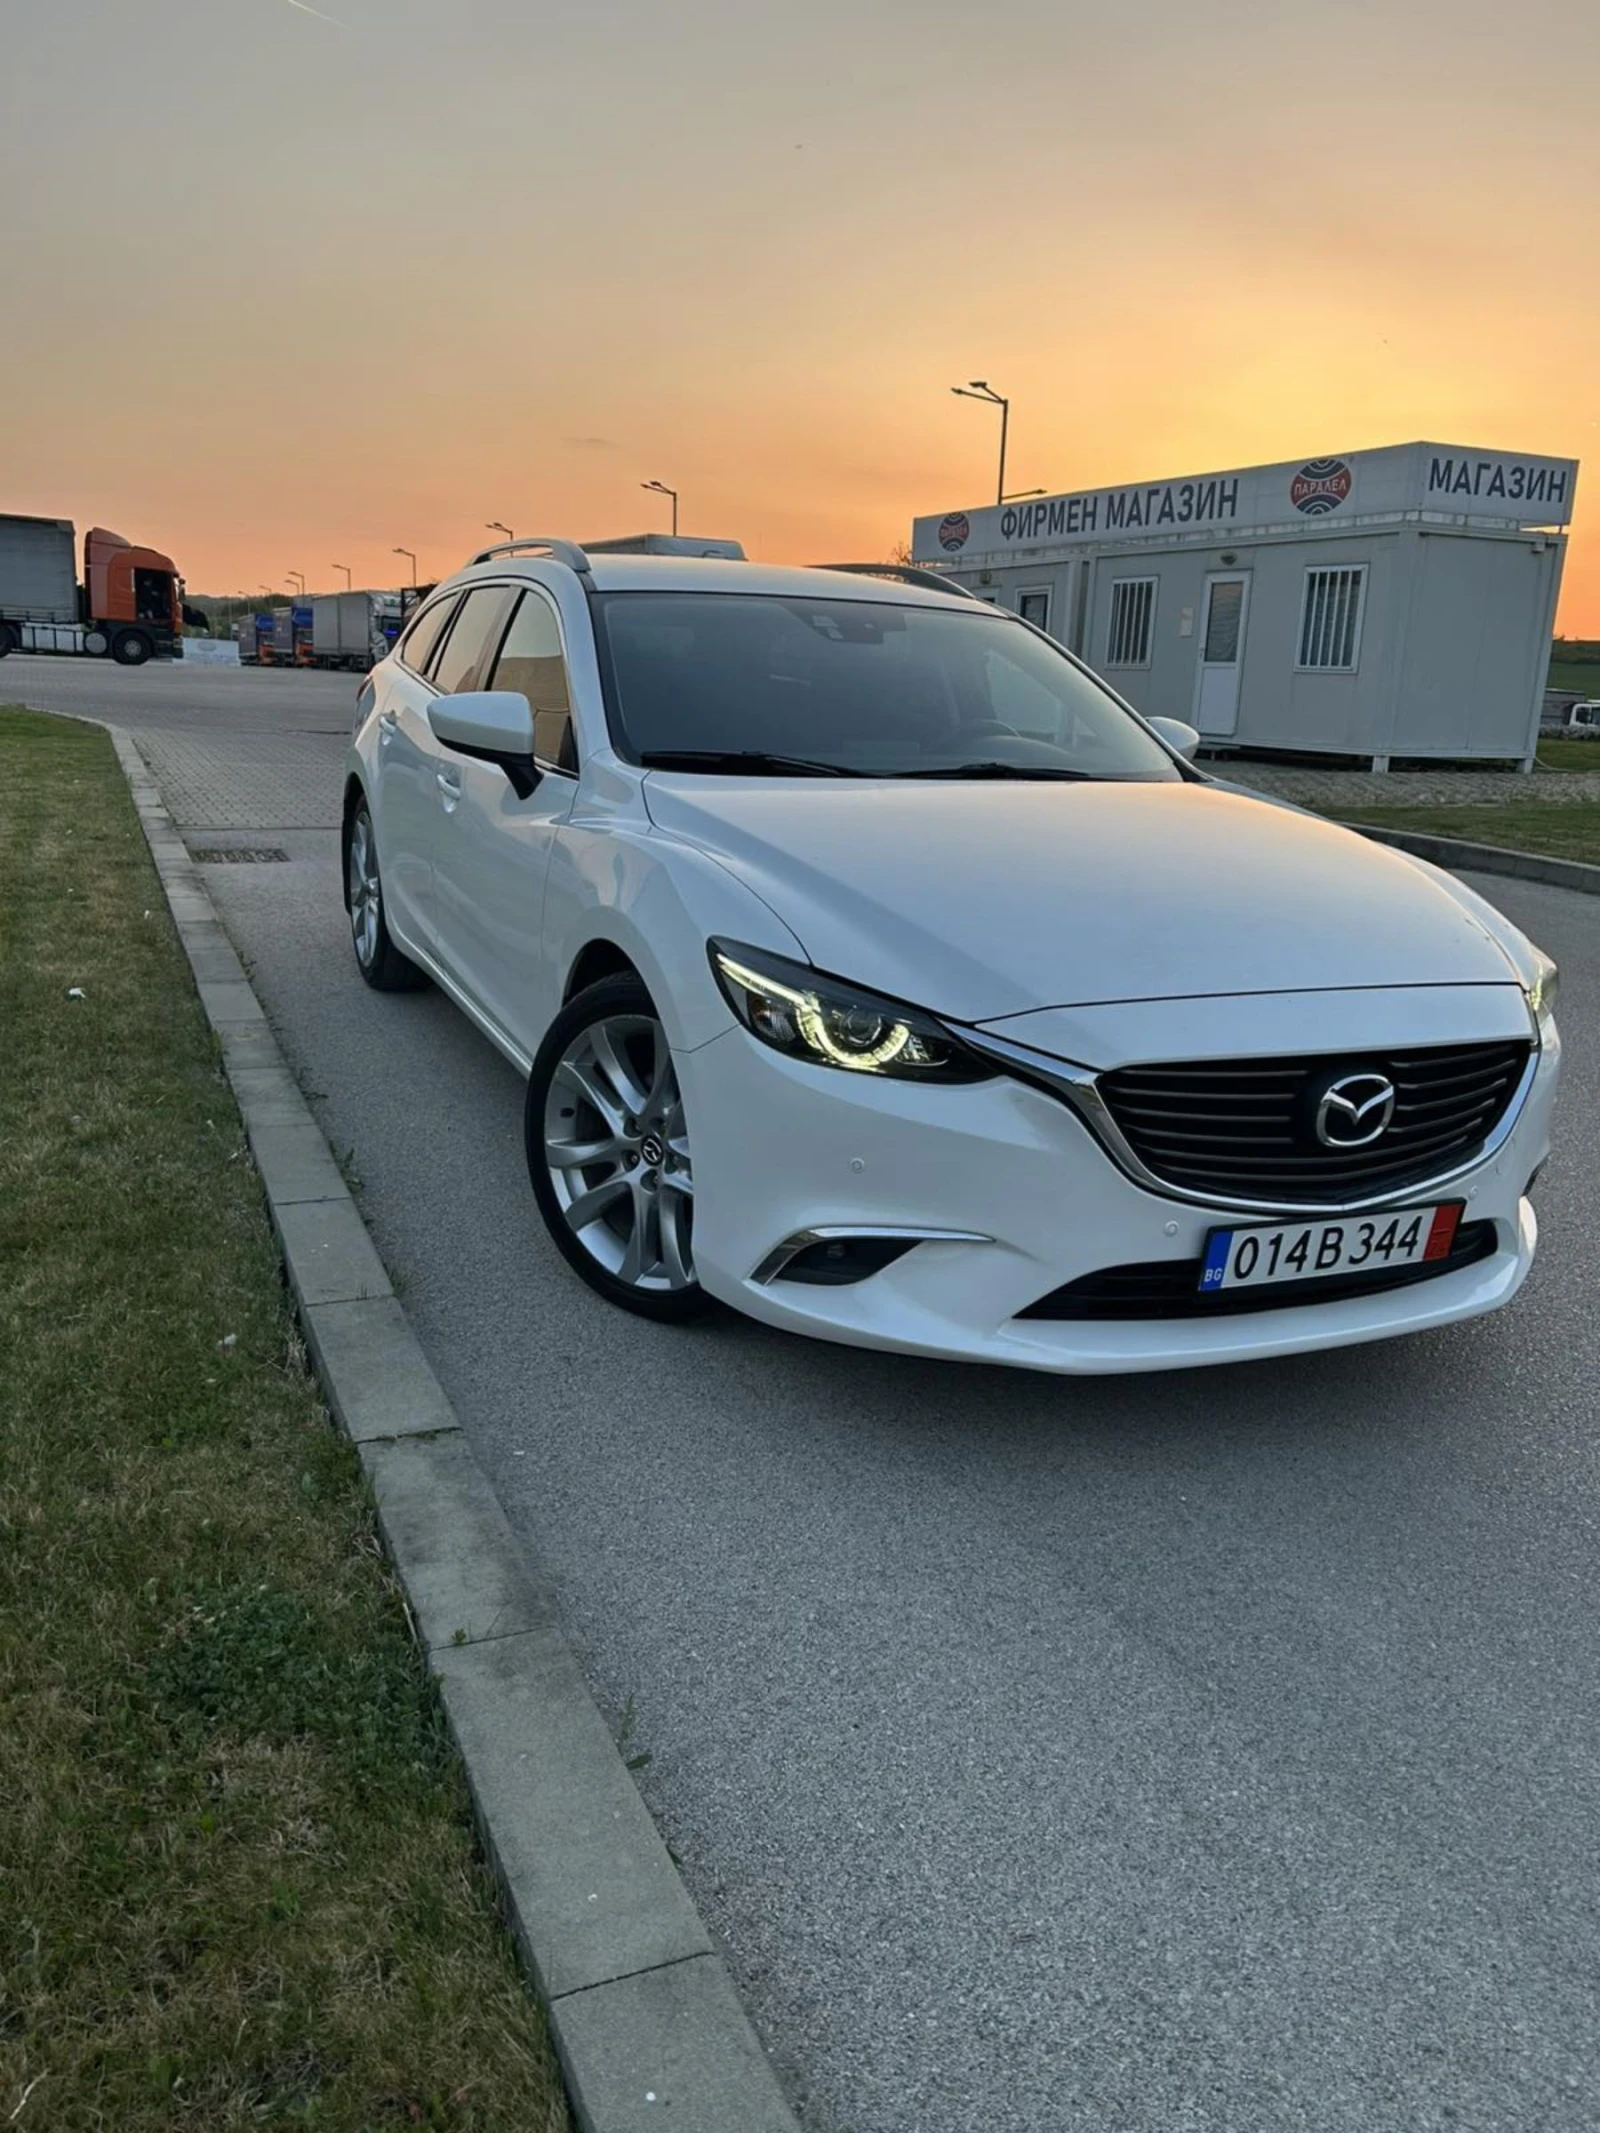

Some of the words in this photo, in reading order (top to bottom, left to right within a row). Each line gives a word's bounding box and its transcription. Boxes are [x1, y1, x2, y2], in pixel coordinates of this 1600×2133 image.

[1294, 478, 1346, 496] ПАРАЛЕЛ
[1429, 458, 1566, 502] МАГАЗИН
[1001, 496, 1097, 540] ФИРМЕН
[1105, 479, 1239, 529] МАГАЗИН
[1204, 1268, 1223, 1282] BG
